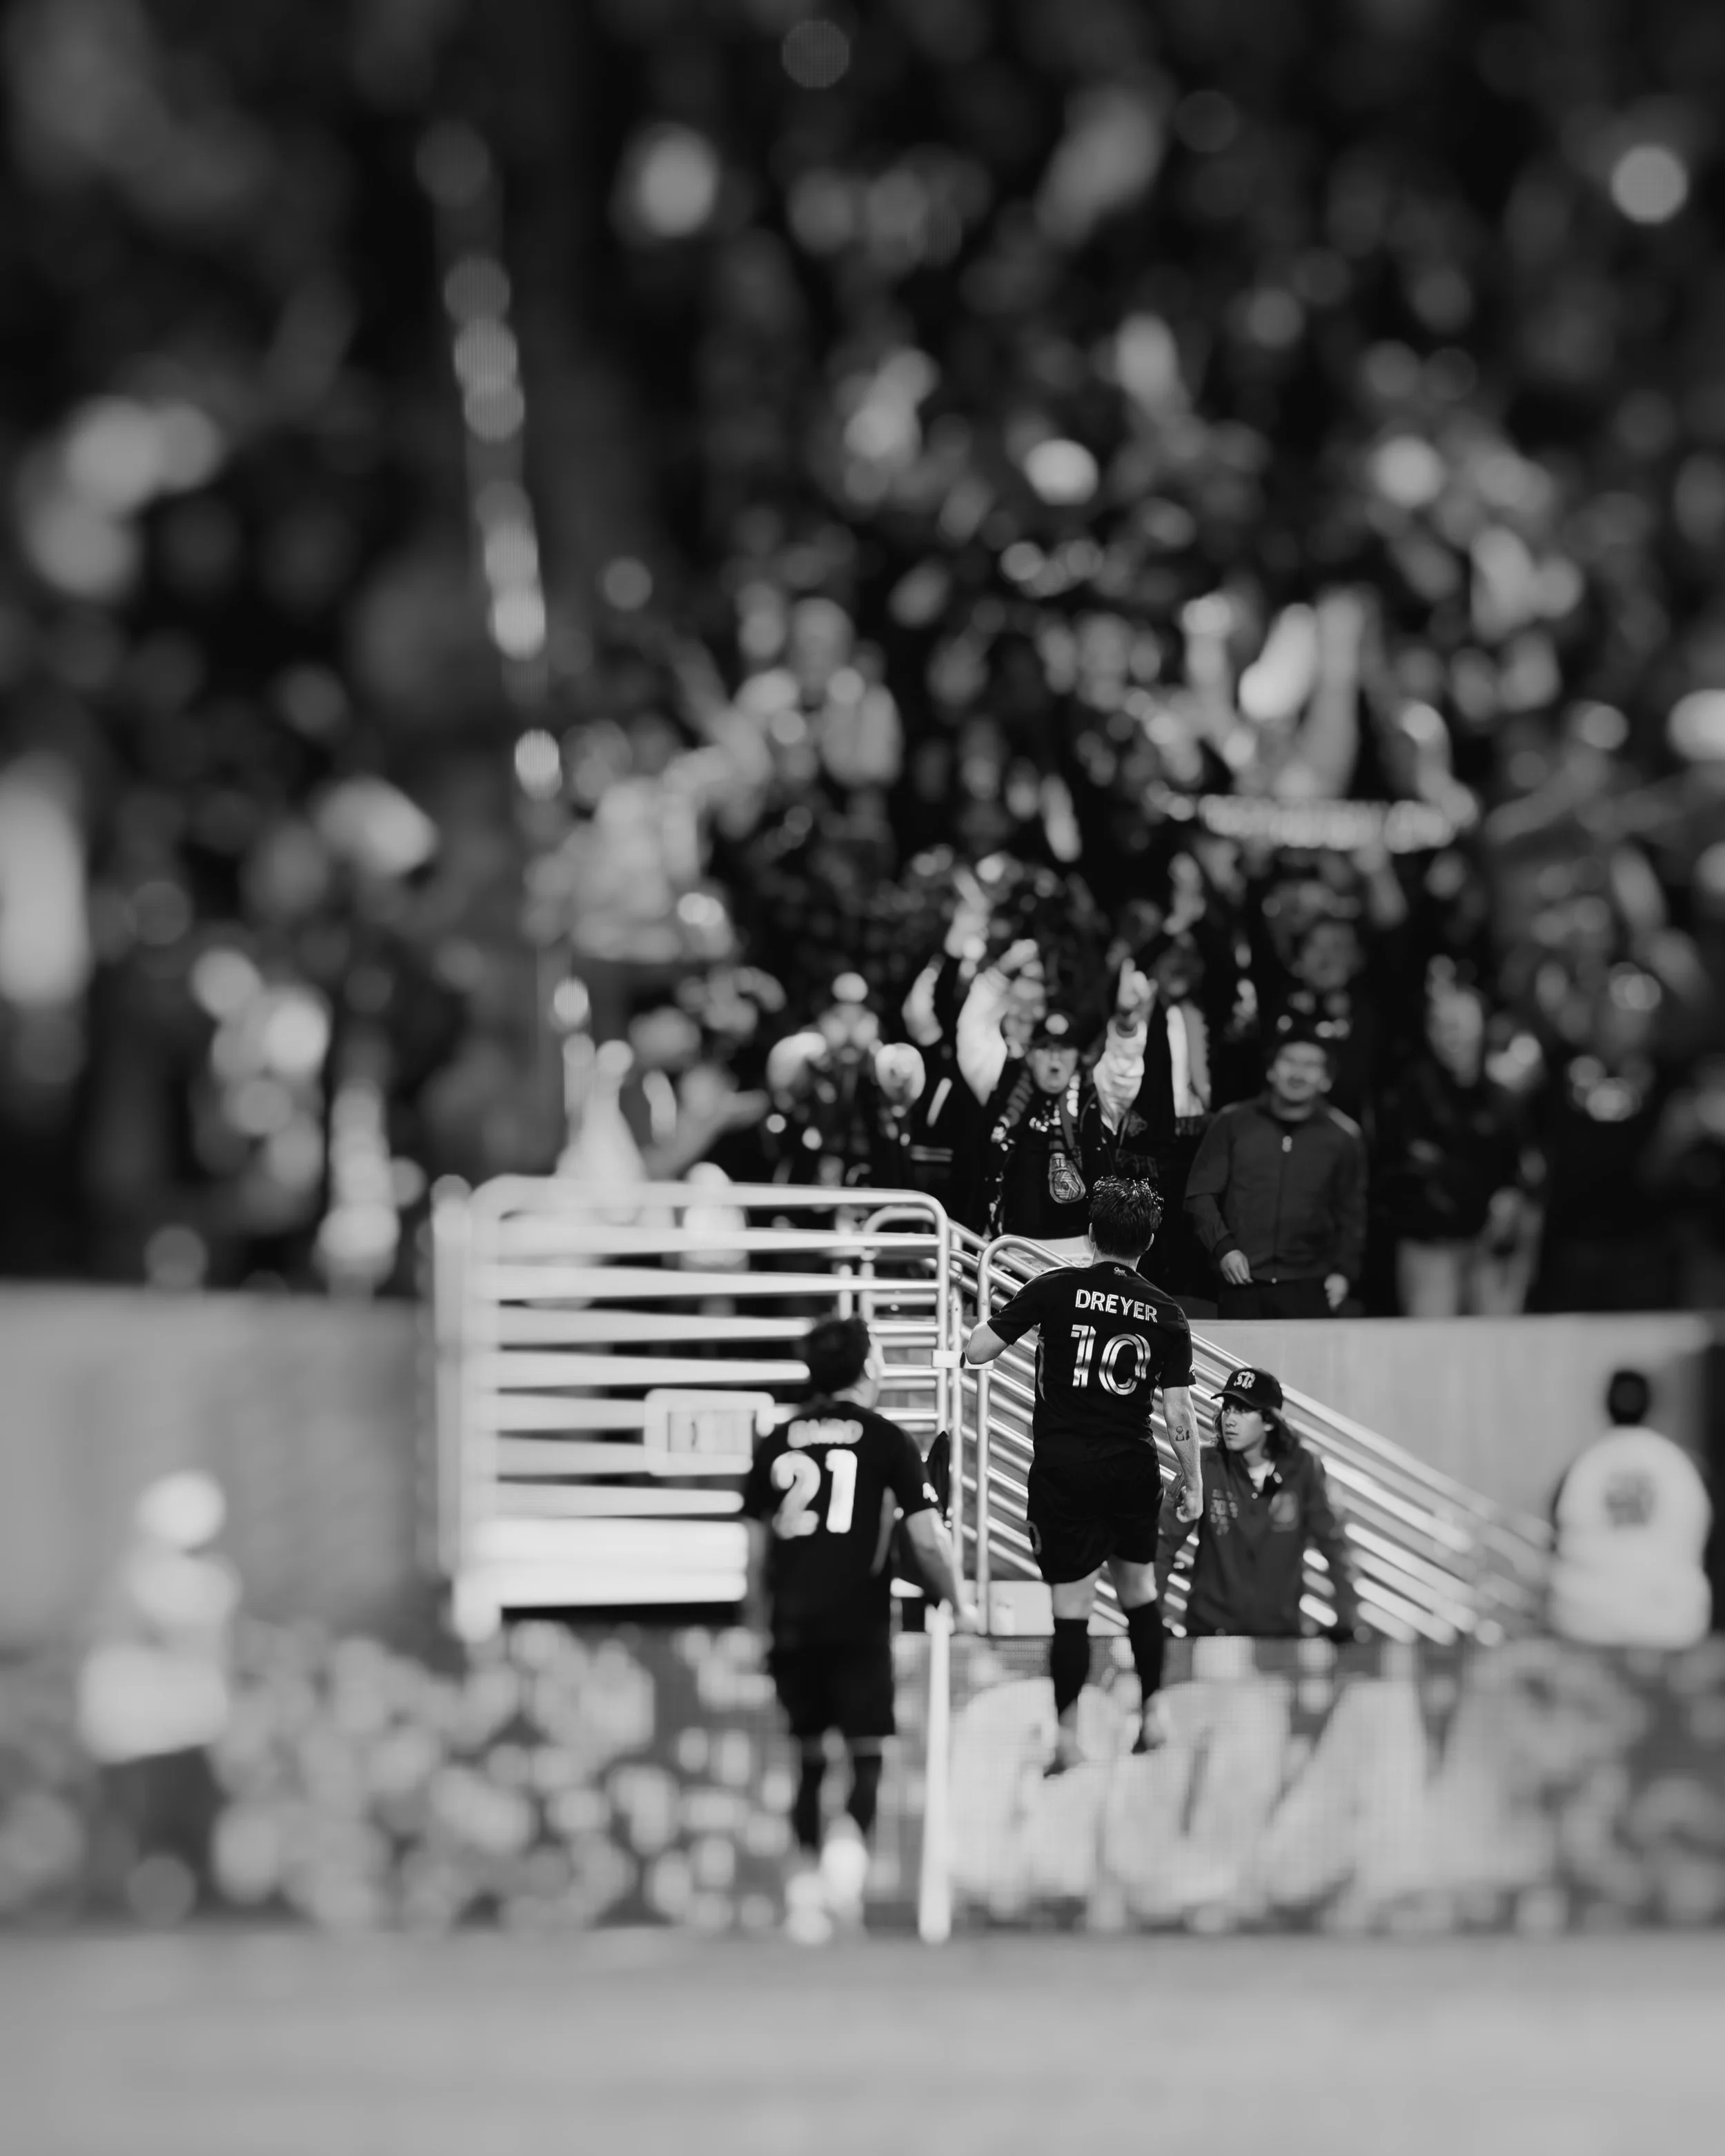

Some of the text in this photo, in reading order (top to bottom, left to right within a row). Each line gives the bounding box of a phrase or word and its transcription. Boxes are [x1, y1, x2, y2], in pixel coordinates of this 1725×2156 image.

[1075, 1289, 1158, 1323] DREYER
[1070, 1324, 1152, 1396] 10
[771, 1449, 858, 1540] 21
